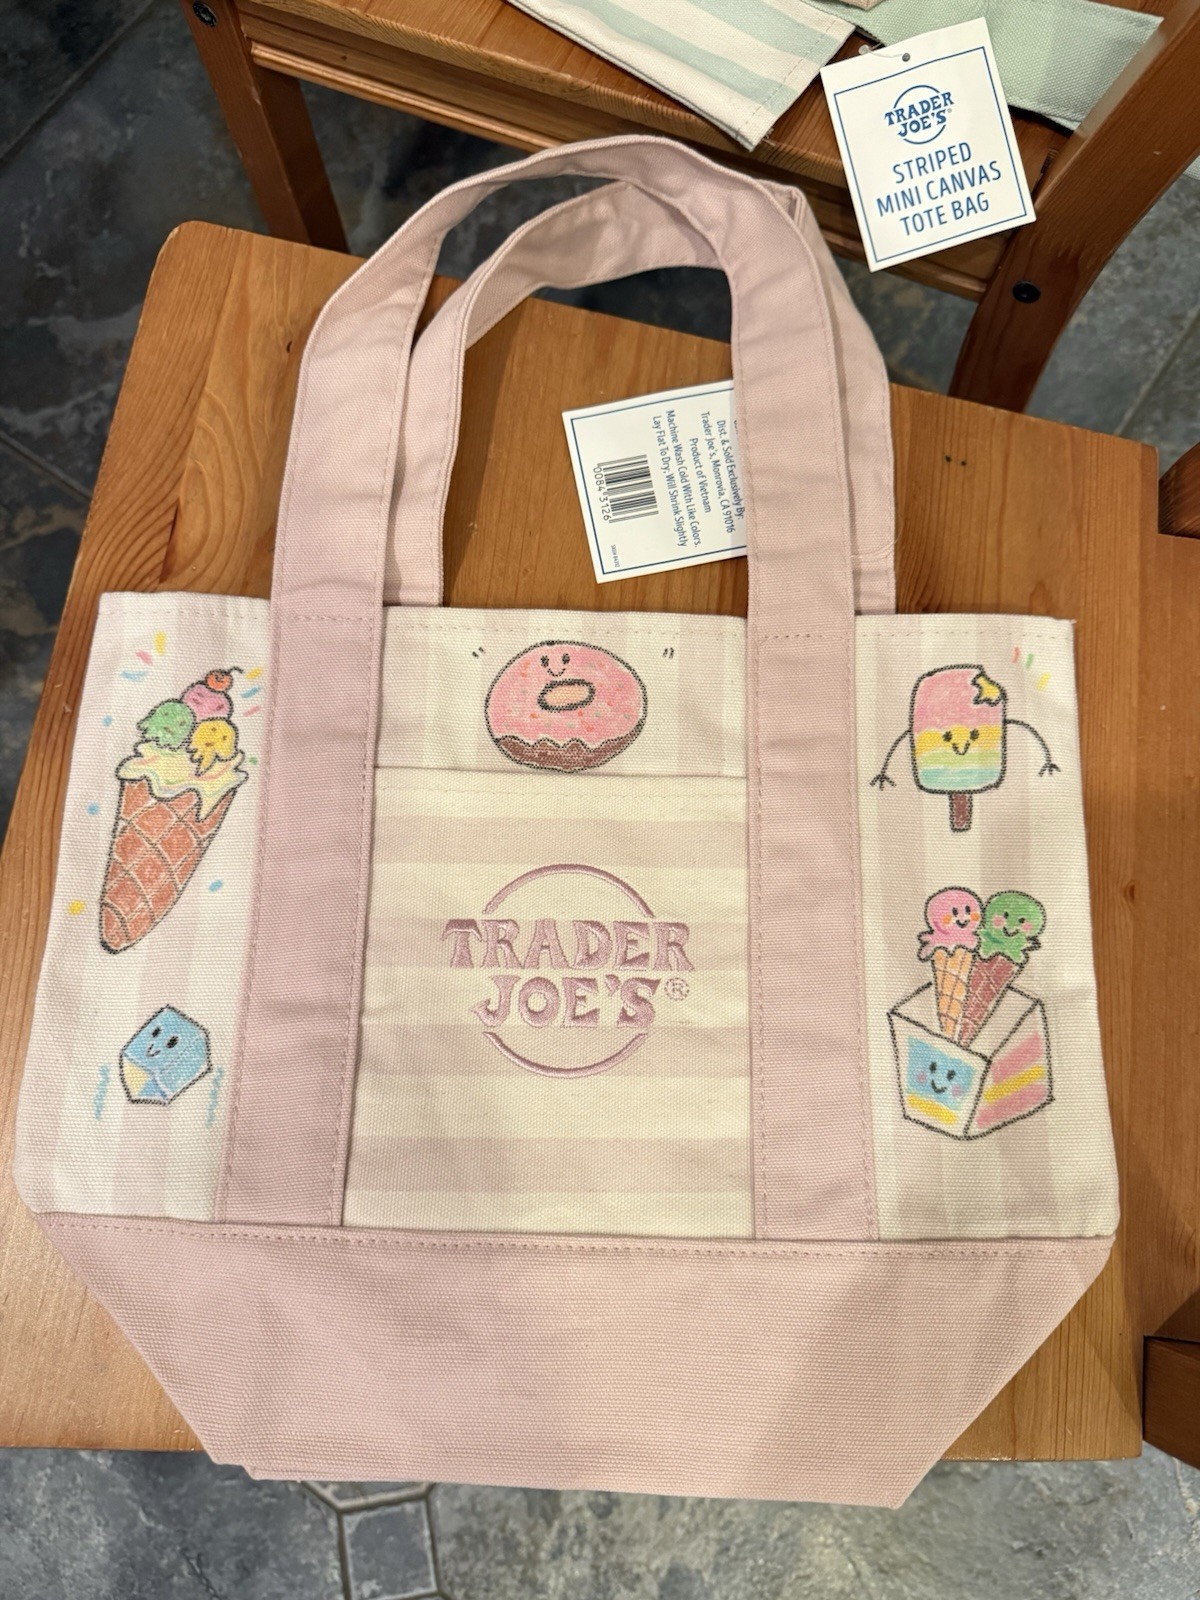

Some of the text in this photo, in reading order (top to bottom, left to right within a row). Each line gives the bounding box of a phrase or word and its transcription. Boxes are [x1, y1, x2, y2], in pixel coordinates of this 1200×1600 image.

[884, 91, 954, 126] TRADER
[892, 142, 972, 184] STRIPED
[876, 160, 1002, 217] MINI CANVAS
[899, 192, 989, 236] TOTE BAG
[652, 416, 663, 429] Lay
[701, 411, 712, 436] Trader
[717, 420, 728, 437] Dist.
[656, 430, 666, 446] Flat
[660, 446, 669, 456] To
[723, 446, 734, 463] Sold
[666, 410, 701, 547] Machine Wash Cold With Like Colors.
[666, 473, 677, 489] Will
[689, 438, 711, 513] Product of Vietnam
[712, 459, 726, 499] Monrovia,
[727, 464, 743, 506] Exclusively
[593, 467, 612, 520] 0084 3126
[669, 490, 682, 516] Shrink
[720, 499, 730, 510] CA
[674, 516, 688, 546] Slightly
[723, 510, 736, 533] 91016
[440, 918, 696, 972] TRADER
